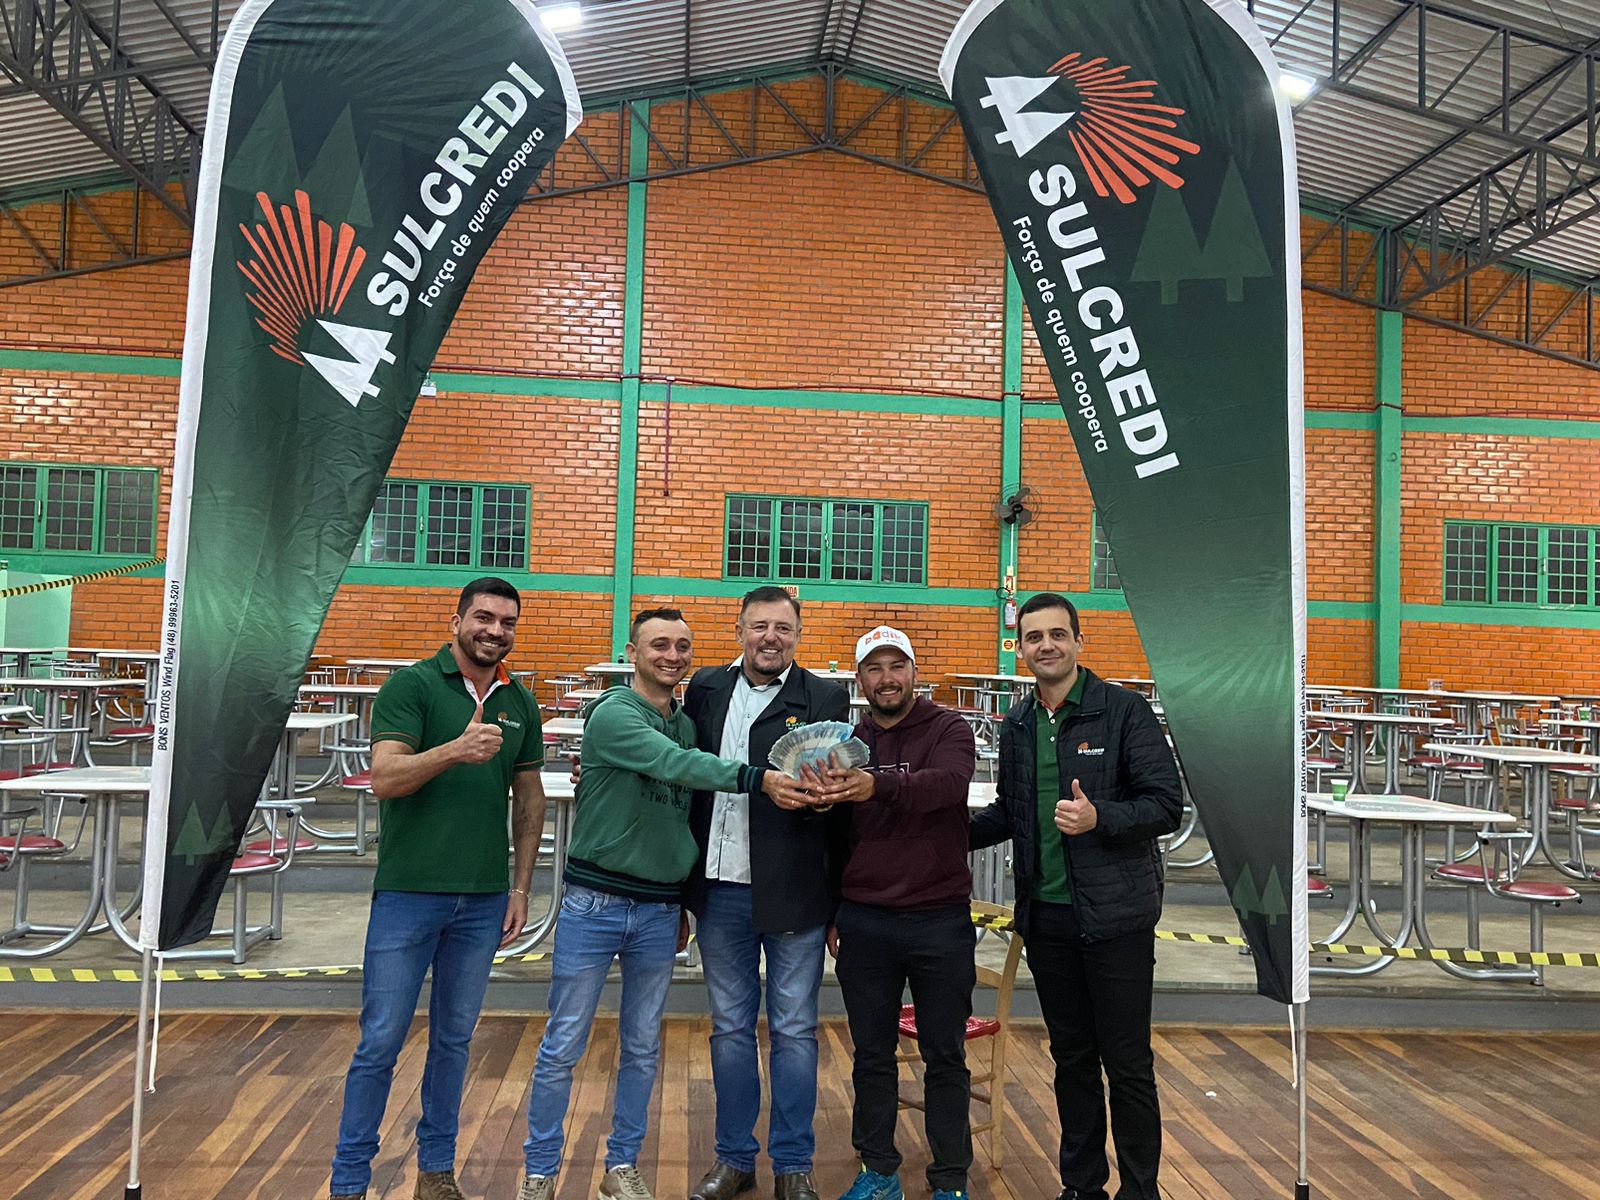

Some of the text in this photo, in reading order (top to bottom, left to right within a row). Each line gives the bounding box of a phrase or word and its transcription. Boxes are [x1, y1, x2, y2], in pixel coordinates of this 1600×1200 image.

[367, 61, 545, 316] SULCREDI
[418, 127, 545, 308] Força de quem coopera
[1012, 215, 1108, 453] Força de quem coopera
[1028, 163, 1180, 479] SULCREDI
[158, 580, 180, 751] BONS VENTOS Wind Flag (48) 99963-5201
